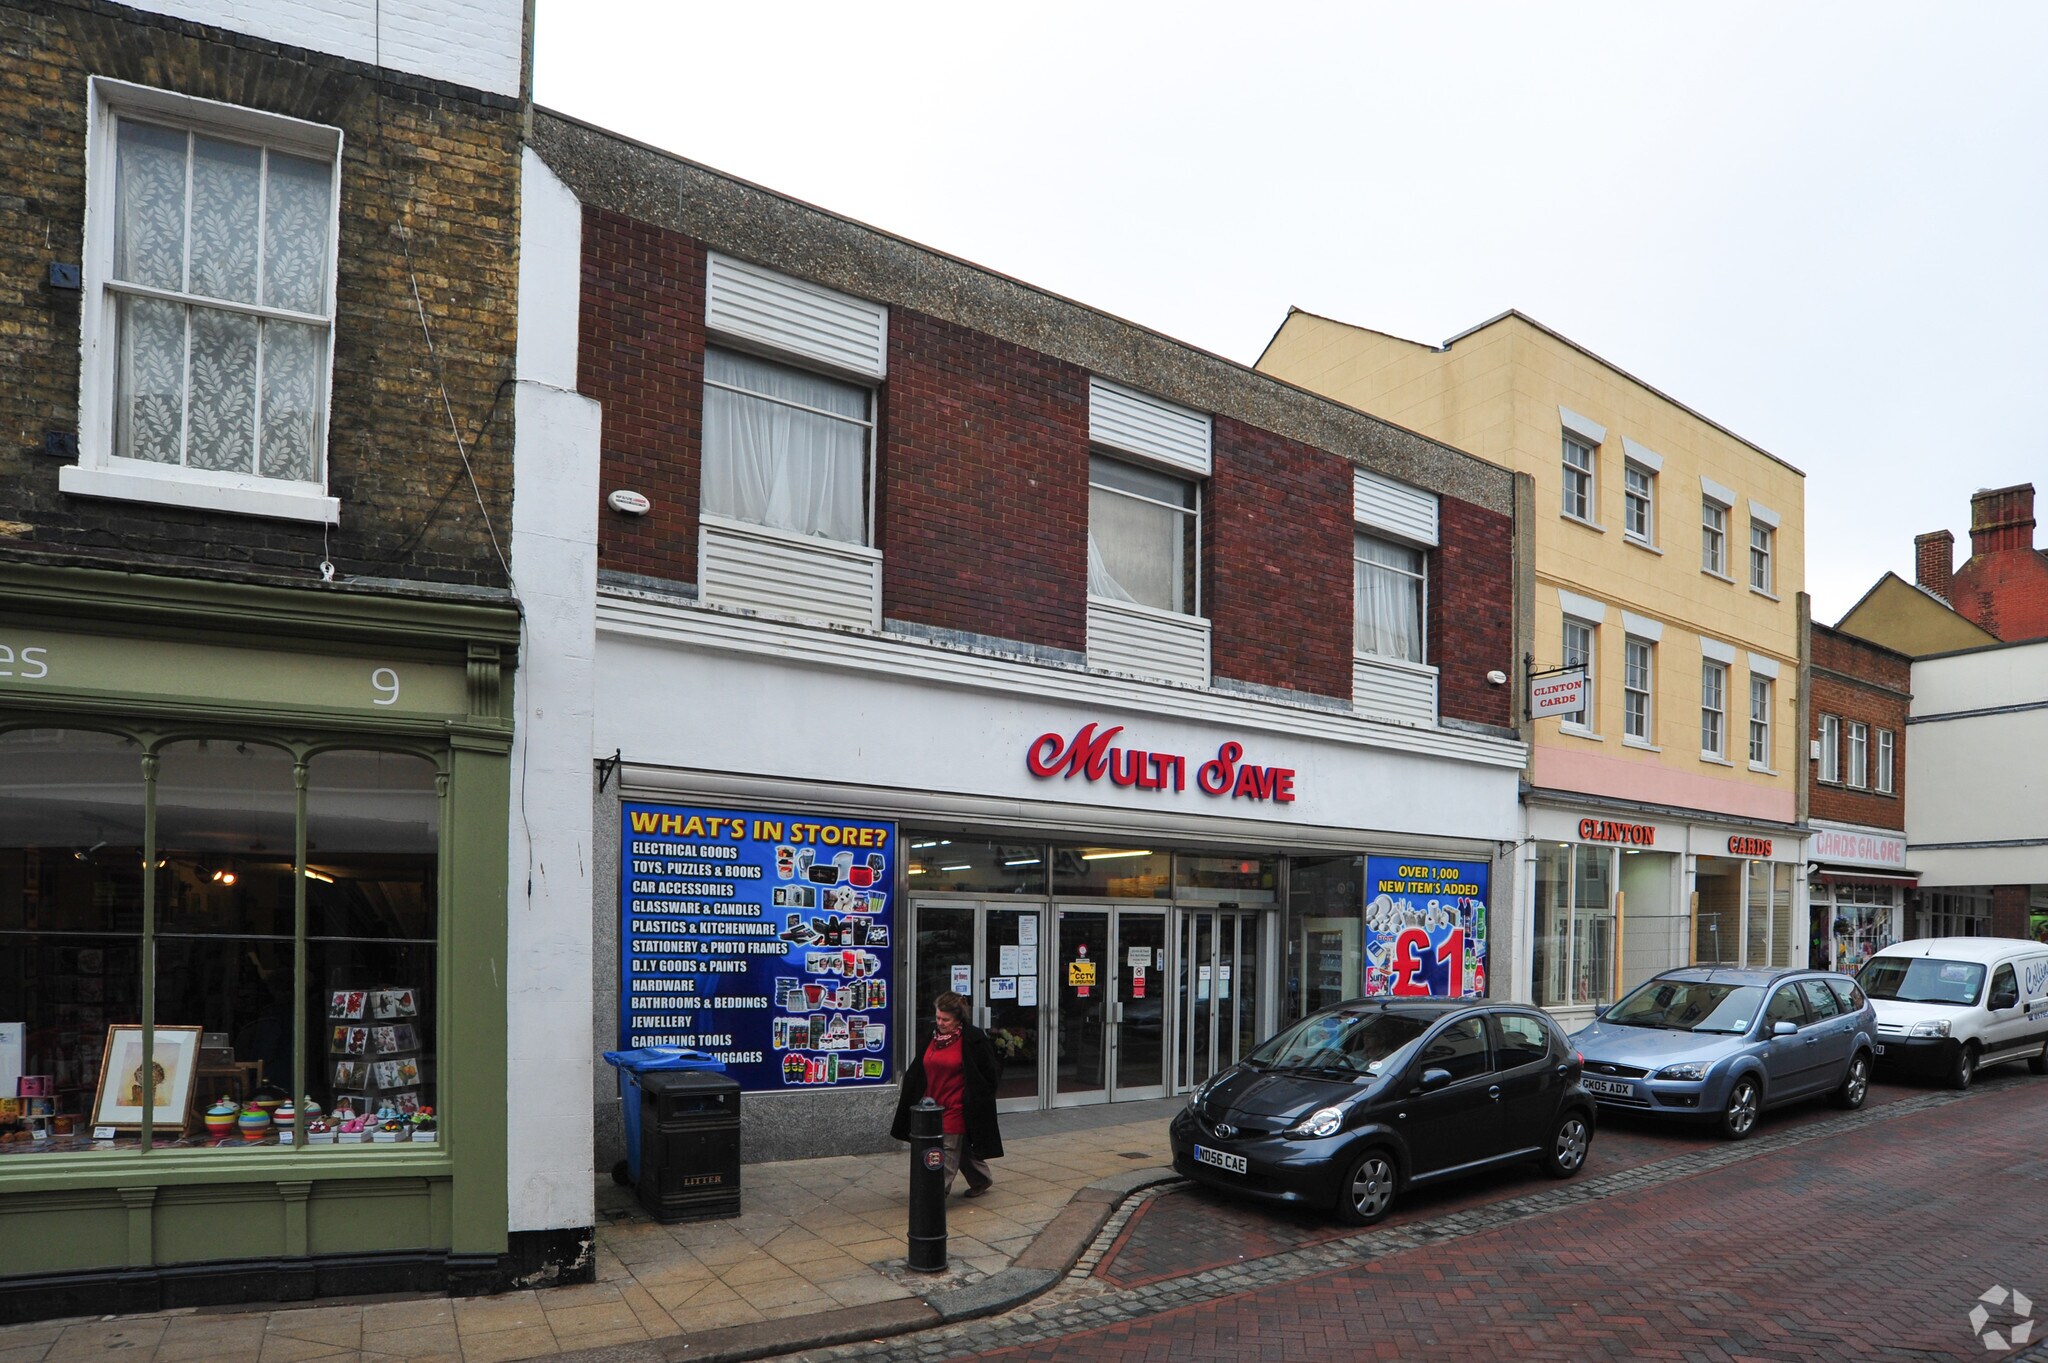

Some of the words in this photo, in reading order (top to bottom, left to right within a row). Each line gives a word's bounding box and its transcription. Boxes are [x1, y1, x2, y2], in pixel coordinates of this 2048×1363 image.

[371, 667, 400, 705] 9
[1533, 680, 1582, 697] CLINTON
[1540, 694, 1576, 708] CARDS
[630, 811, 746, 839] WHAT'S
[753, 820, 783, 841] IN
[790, 823, 888, 848] STORE?
[1579, 818, 1656, 845] CLINTON
[632, 841, 698, 857] ELECTRICAL
[699, 845, 738, 860] GOODS
[1728, 836, 1773, 857] CARDS
[1816, 832, 1857, 858] CARDS
[1858, 837, 1901, 863] GALORE
[632, 860, 666, 875] TOYS,
[667, 862, 712, 877] PUZZLES
[714, 866, 723, 877] &
[724, 865, 761, 879] BOOKS
[1398, 865, 1429, 879] OVER
[1431, 867, 1459, 880] 1,000
[632, 880, 656, 894] CAR
[658, 881, 734, 897] ACCESSORIES
[1378, 881, 1405, 894] NEW
[1407, 882, 1441, 895] ITEM'S
[1443, 884, 1478, 896] ADDED
[632, 900, 701, 915] GLASSWARE
[702, 903, 711, 915] &
[713, 902, 761, 917] CANDLES
[632, 920, 687, 934] PLASTICS
[688, 922, 697, 934] &
[699, 922, 776, 936] KITCHENWARE
[1376, 934, 1394, 942] From
[632, 940, 699, 953] STATIONERY
[700, 942, 709, 954] &
[710, 942, 746, 954] PHOTO
[747, 942, 788, 955] FRAMES
[632, 959, 657, 972] D.I.Y
[659, 959, 697, 973] GOODS
[698, 961, 708, 973] &
[709, 960, 747, 973] PAINTS
[1392, 927, 1464, 998] £1
[1074, 972, 1094, 980] CCTV
[632, 979, 695, 992] HARDWARE
[631, 997, 701, 1009] BATHROOMS
[703, 998, 712, 1009] &
[714, 997, 768, 1009] BEDDINGS
[631, 1016, 692, 1028] JEWELLERY
[631, 1034, 696, 1048] GARDENING
[698, 1034, 732, 1046] TOOLS
[709, 1051, 763, 1064] UGGAGES
[1582, 1079, 1607, 1092] GK05
[1608, 1082, 1629, 1095] ADX
[1199, 1147, 1223, 1166] ND56
[1224, 1155, 1246, 1173] CAE
[683, 1175, 722, 1186] LITTER
